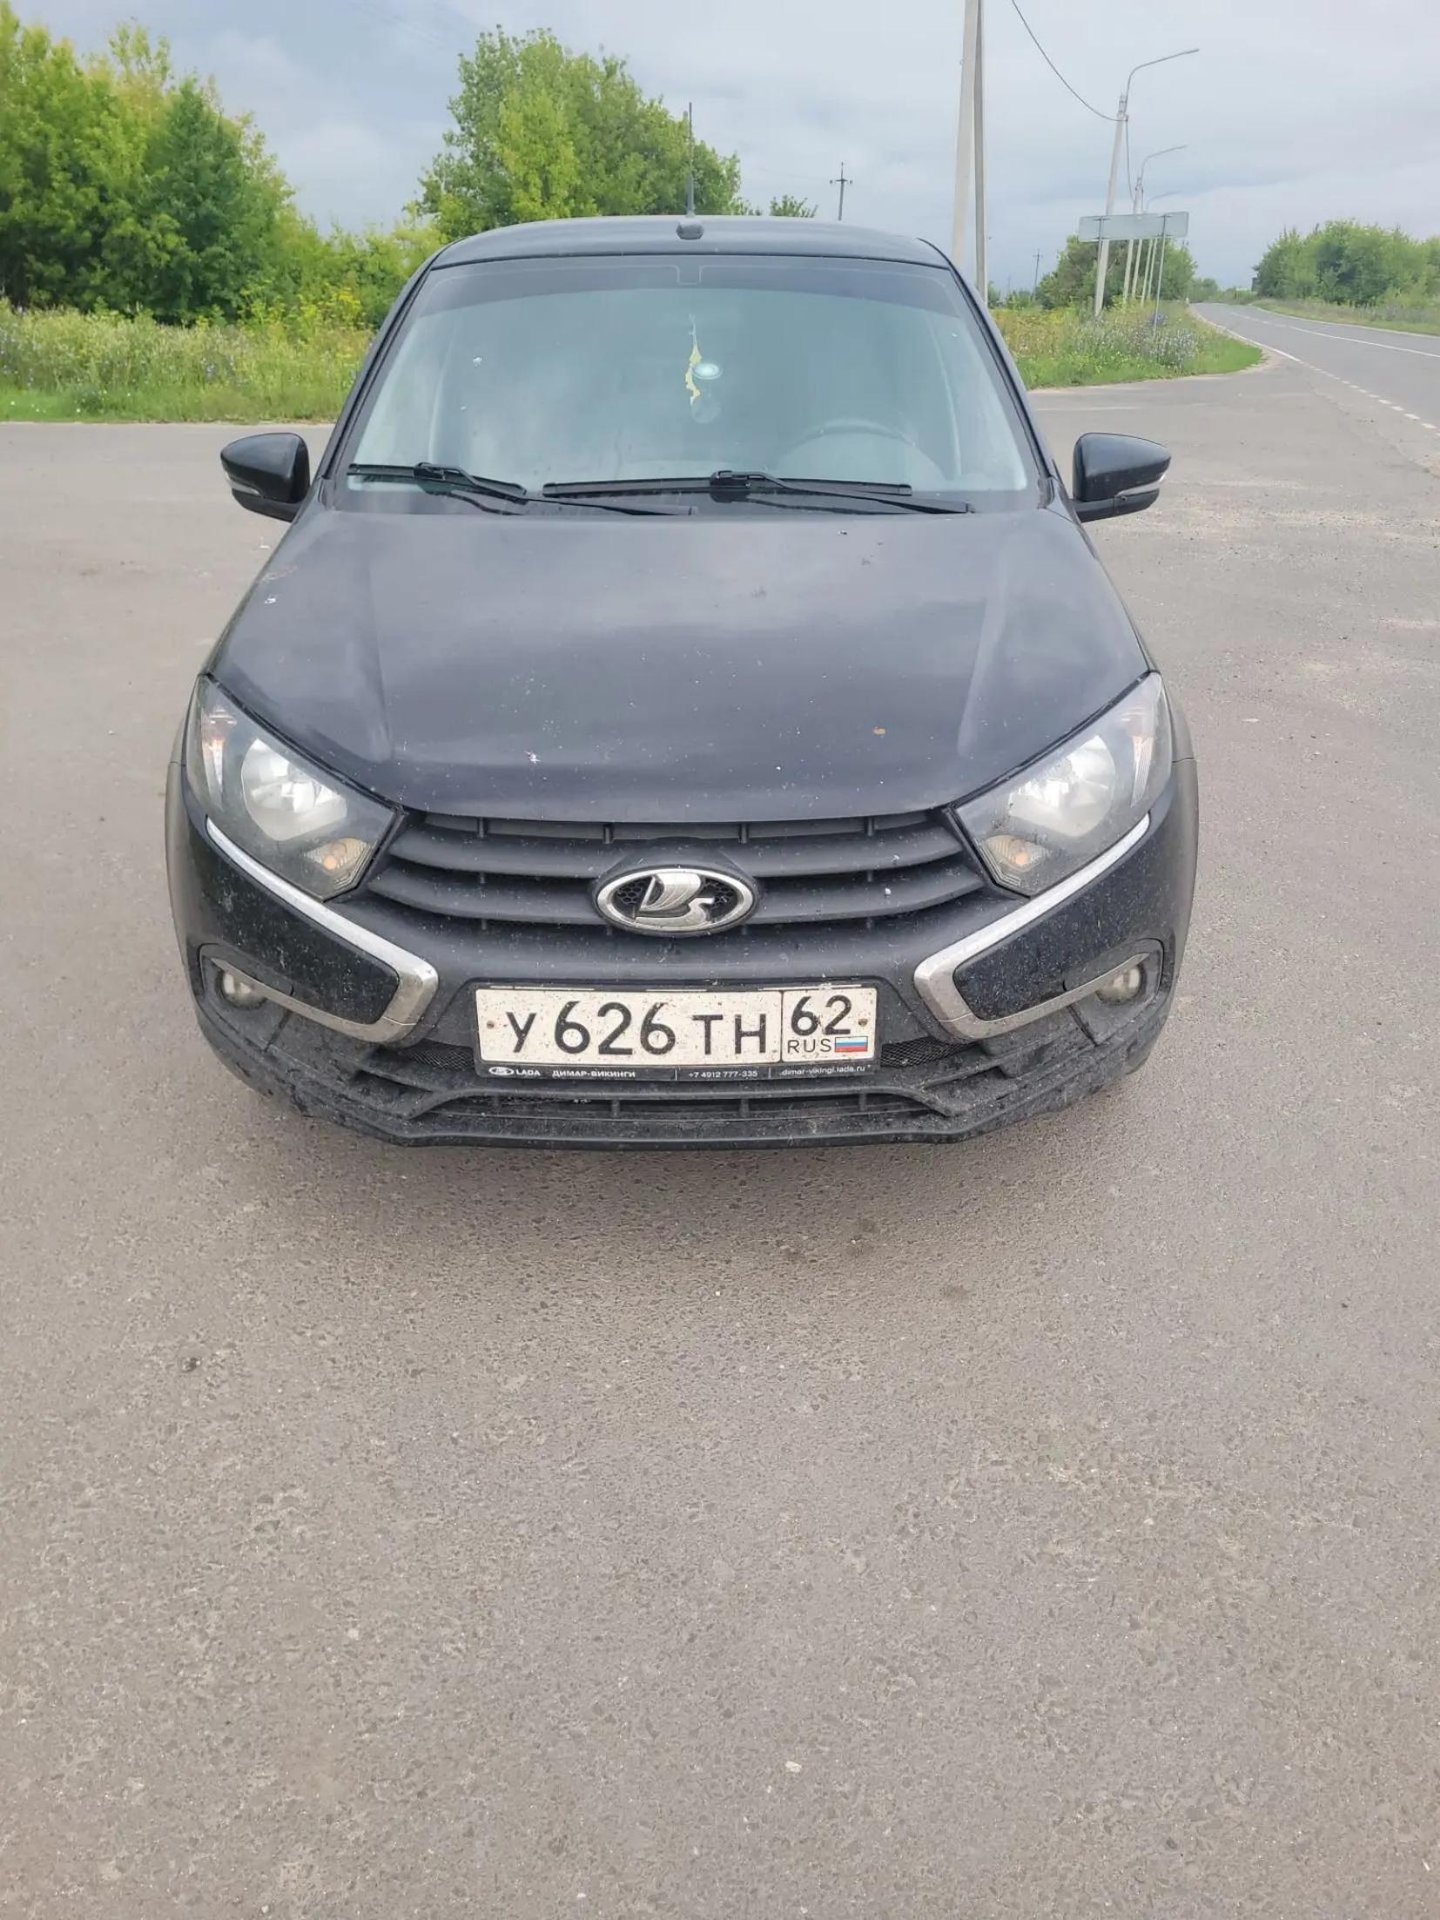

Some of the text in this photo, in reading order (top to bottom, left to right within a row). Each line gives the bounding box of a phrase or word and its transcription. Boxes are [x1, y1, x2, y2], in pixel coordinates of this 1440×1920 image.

[790, 995, 851, 1036] 62
[787, 1037, 832, 1054] RUS
[515, 1068, 541, 1077] LADA
[551, 1069, 636, 1079] ДИМАР-ВИКИНГИ
